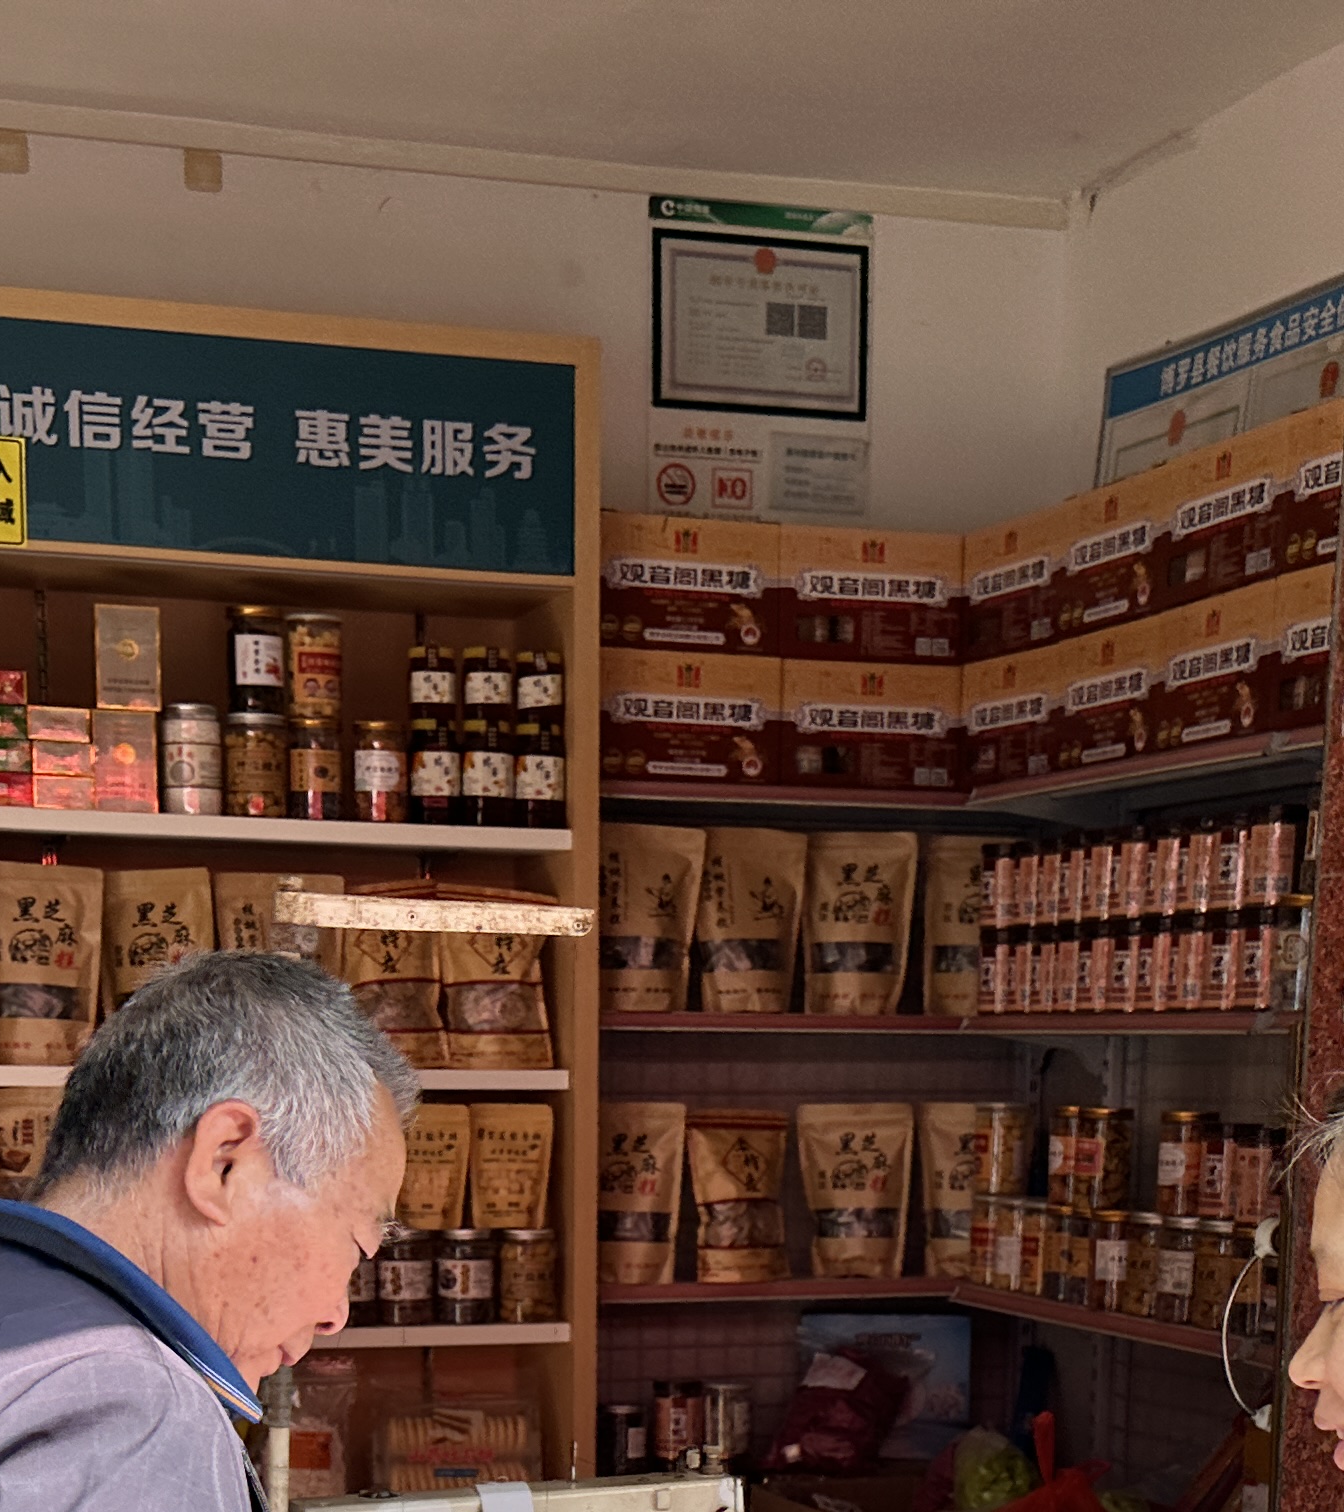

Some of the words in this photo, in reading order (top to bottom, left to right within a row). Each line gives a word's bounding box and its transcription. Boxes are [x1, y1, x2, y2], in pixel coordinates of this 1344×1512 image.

[295, 408, 536, 480] 惠美服务
[619, 563, 752, 590] 观音阁黑糖
[809, 575, 937, 599] 观音阁黑糖
[622, 697, 753, 723] 观音阁黑糖
[808, 708, 935, 731] 观音阁黑糖
